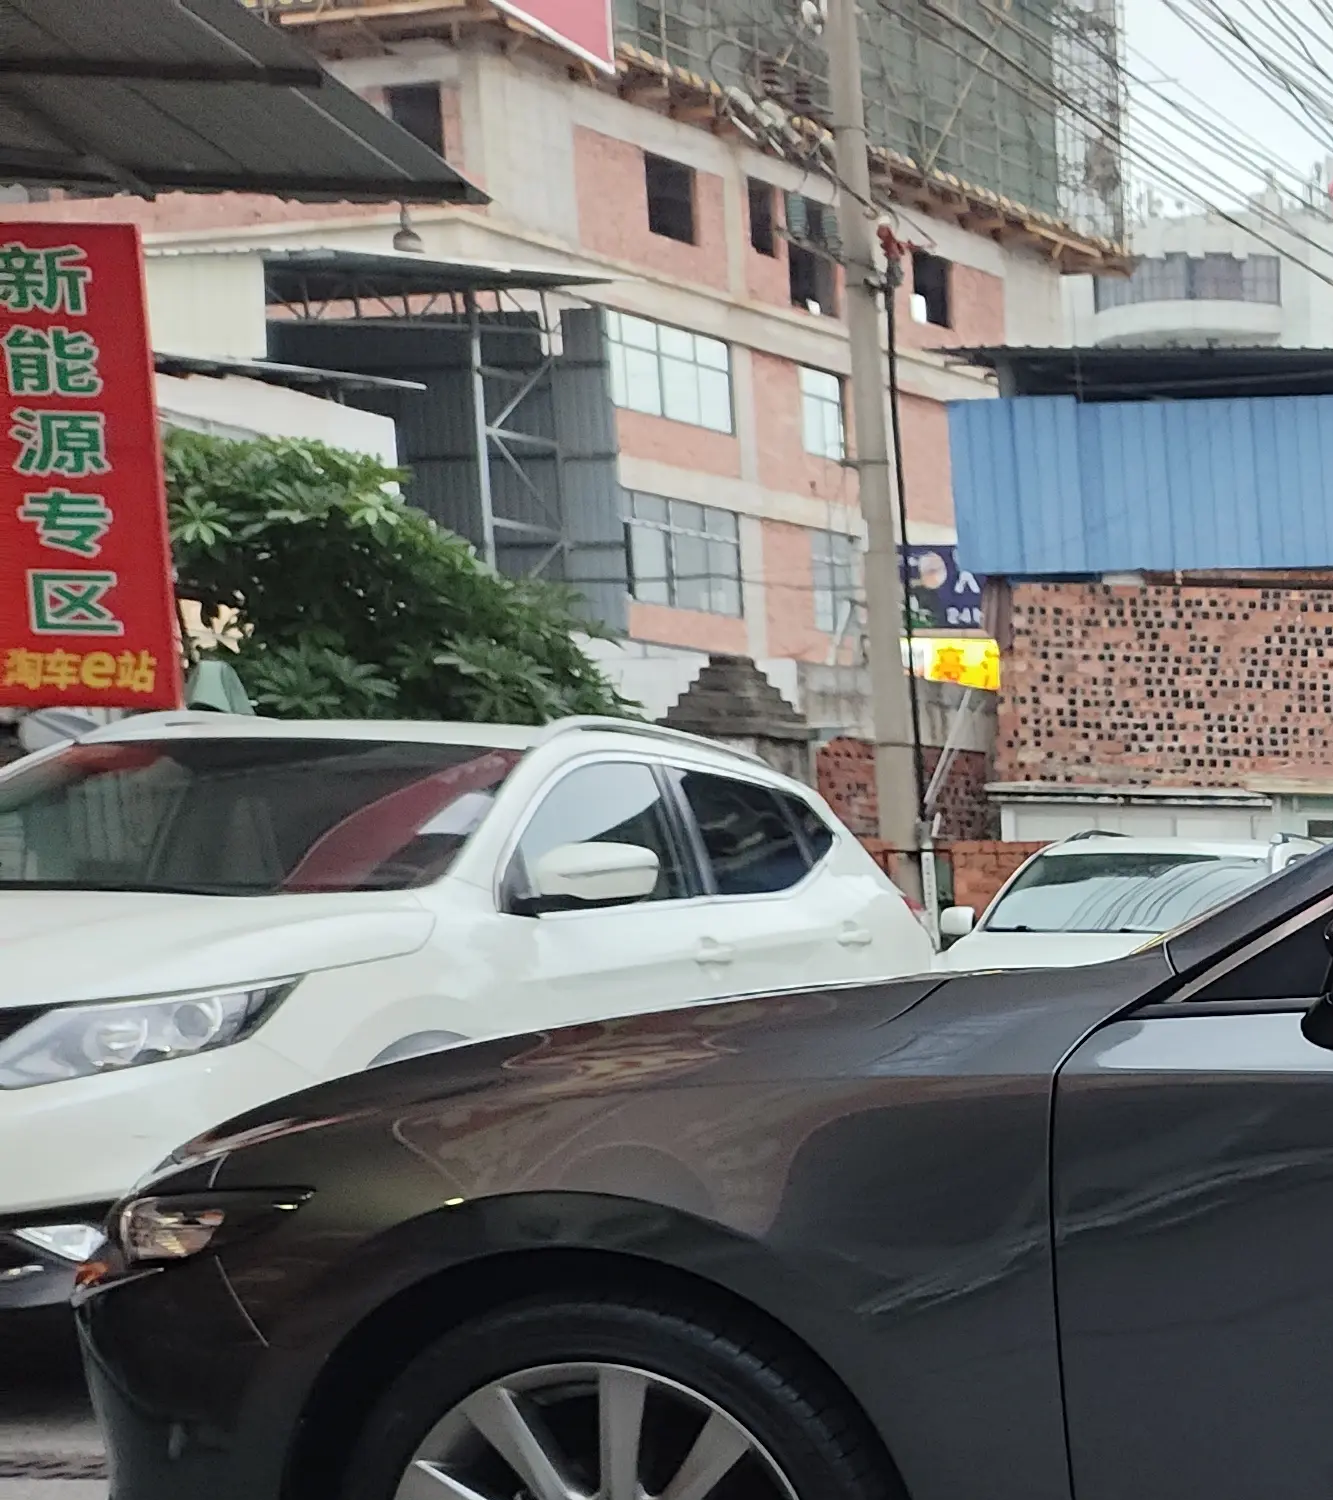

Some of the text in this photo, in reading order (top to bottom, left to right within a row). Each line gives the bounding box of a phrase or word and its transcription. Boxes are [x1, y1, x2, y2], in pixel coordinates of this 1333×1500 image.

[0, 241, 125, 636] 新能源专区
